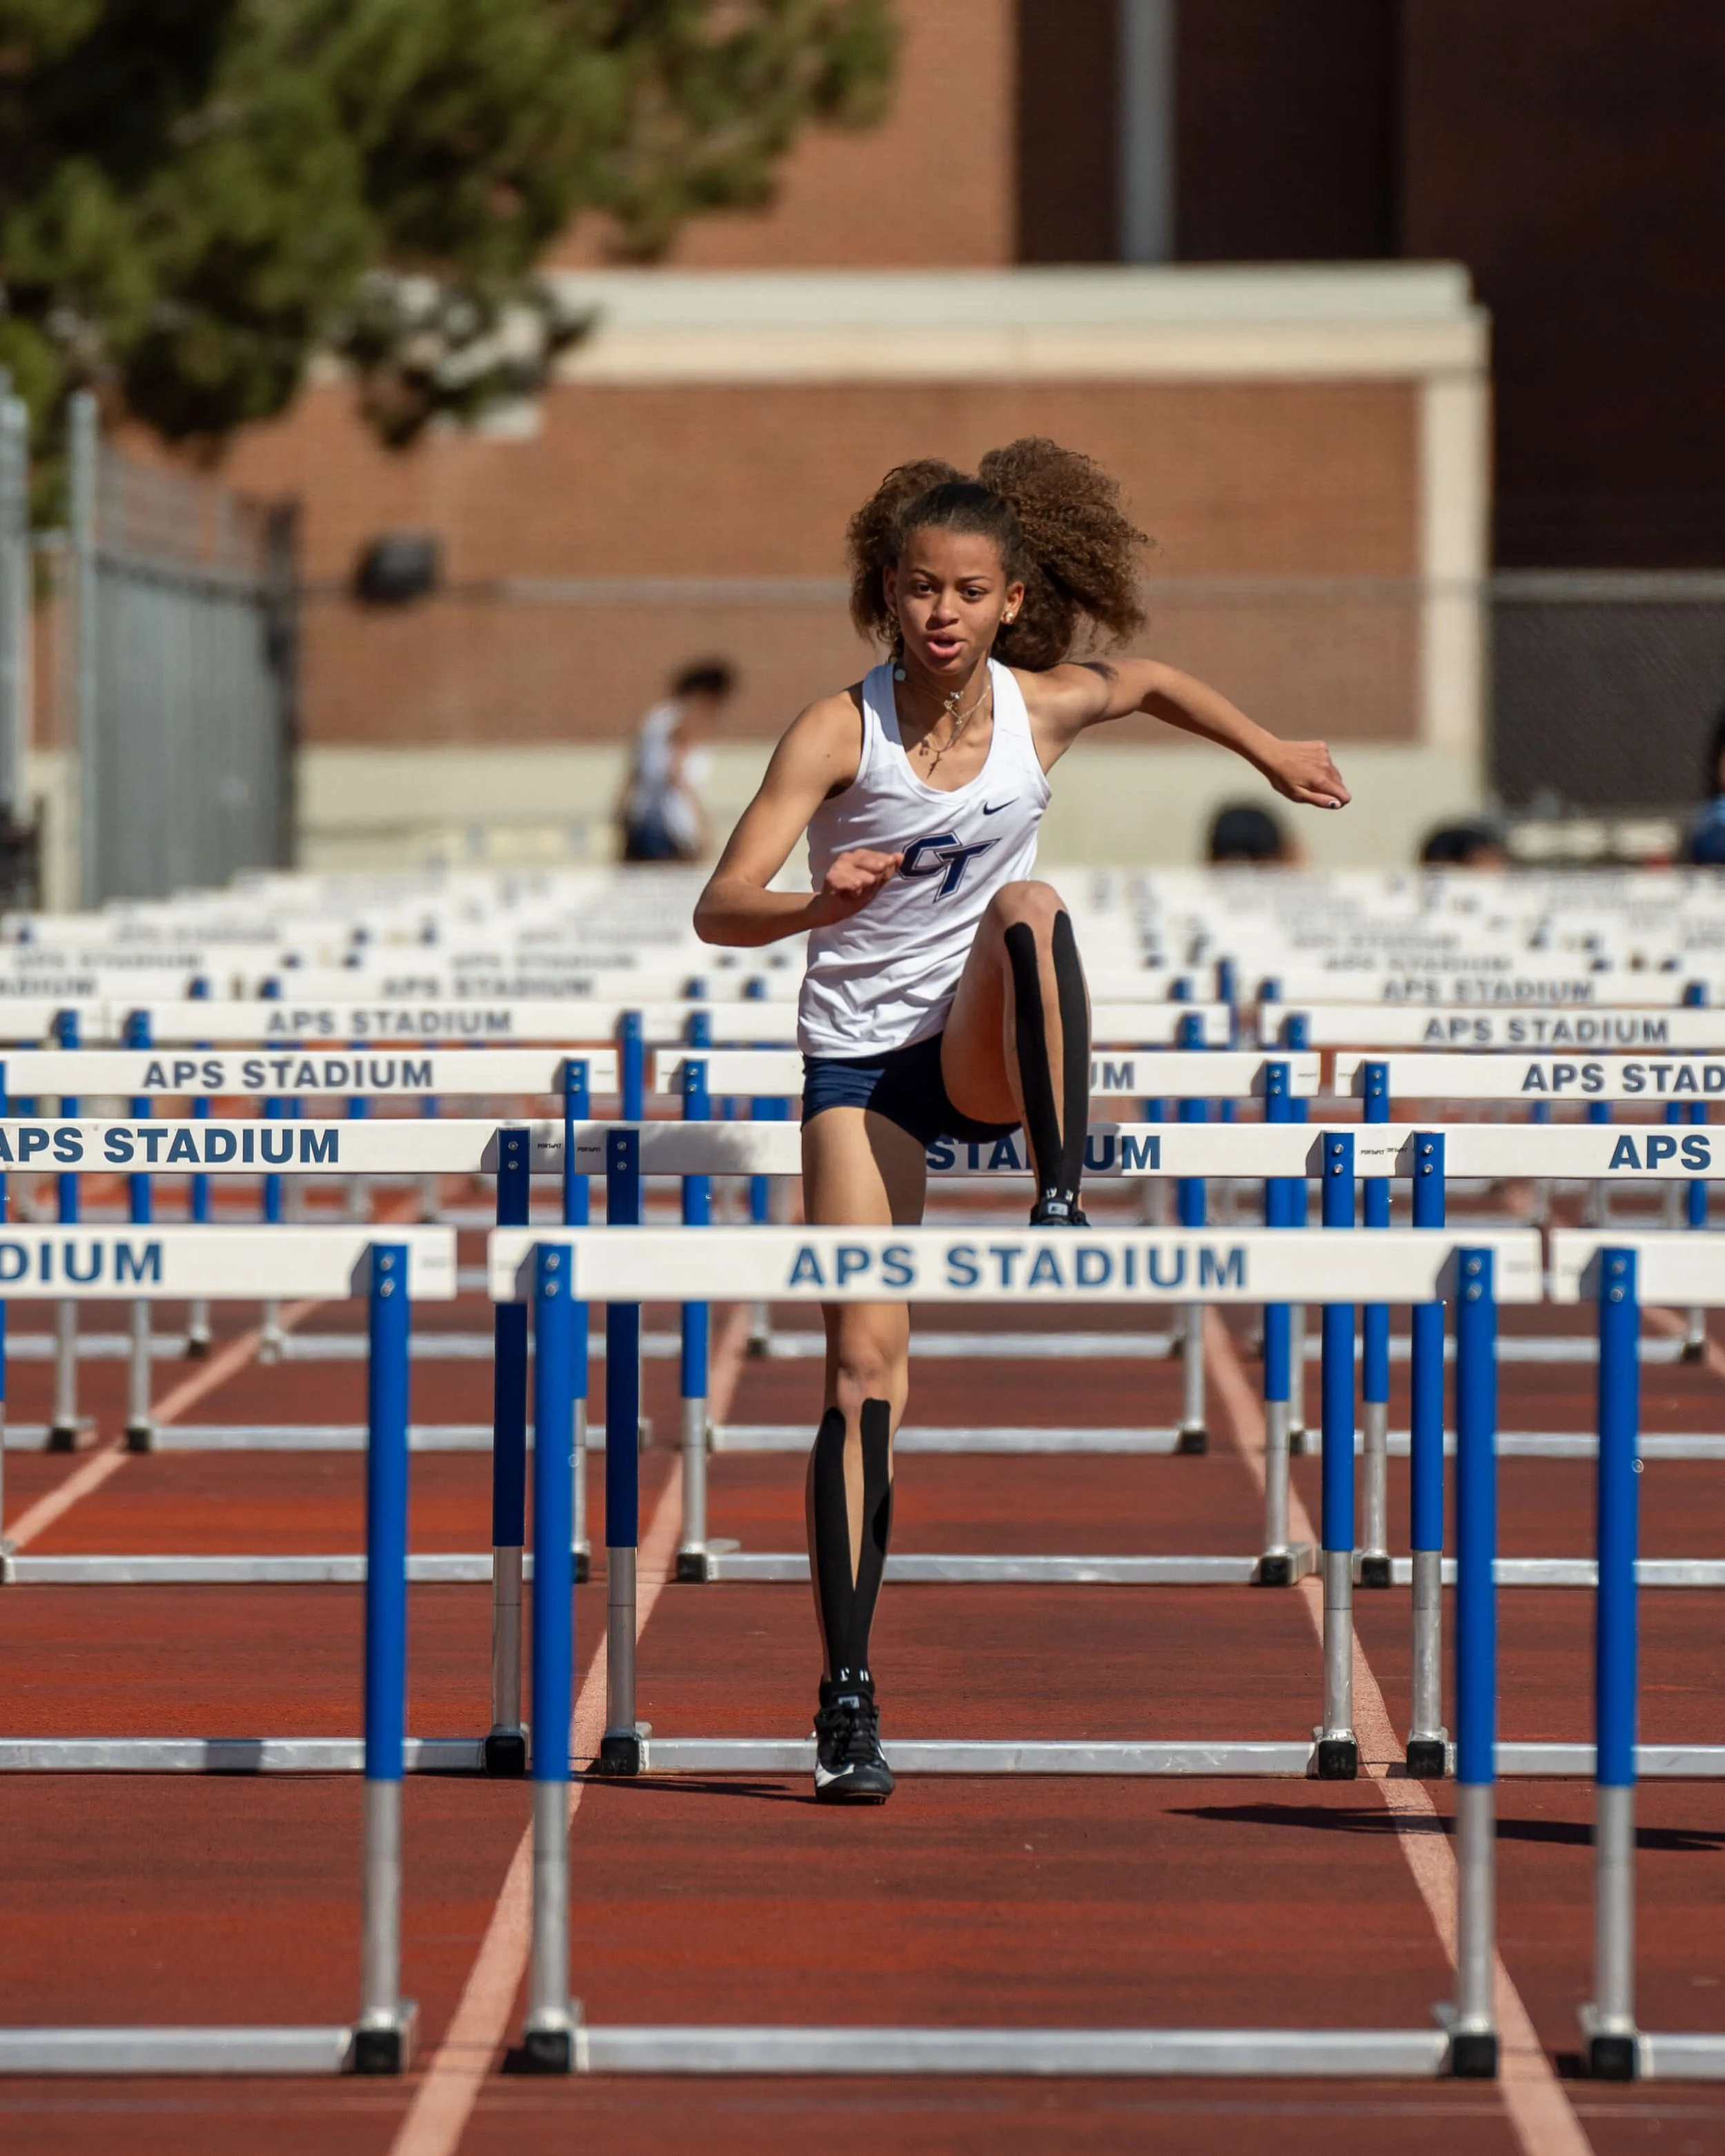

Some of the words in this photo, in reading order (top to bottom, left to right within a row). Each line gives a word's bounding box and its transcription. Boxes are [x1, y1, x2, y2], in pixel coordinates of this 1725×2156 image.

[268, 1011, 335, 1034] APS
[351, 1011, 512, 1034] STADIUM
[1423, 1018, 1492, 1042] APS
[1508, 1019, 1668, 1043] STADIUM
[143, 1060, 225, 1089] APS
[241, 1060, 433, 1089] STADIUM
[1521, 1063, 1605, 1092] APS
[103, 1127, 339, 1164] STADIUM
[1608, 1134, 1711, 1171] APS
[789, 1247, 914, 1290] APS
[947, 1247, 1247, 1291] STADIUM
